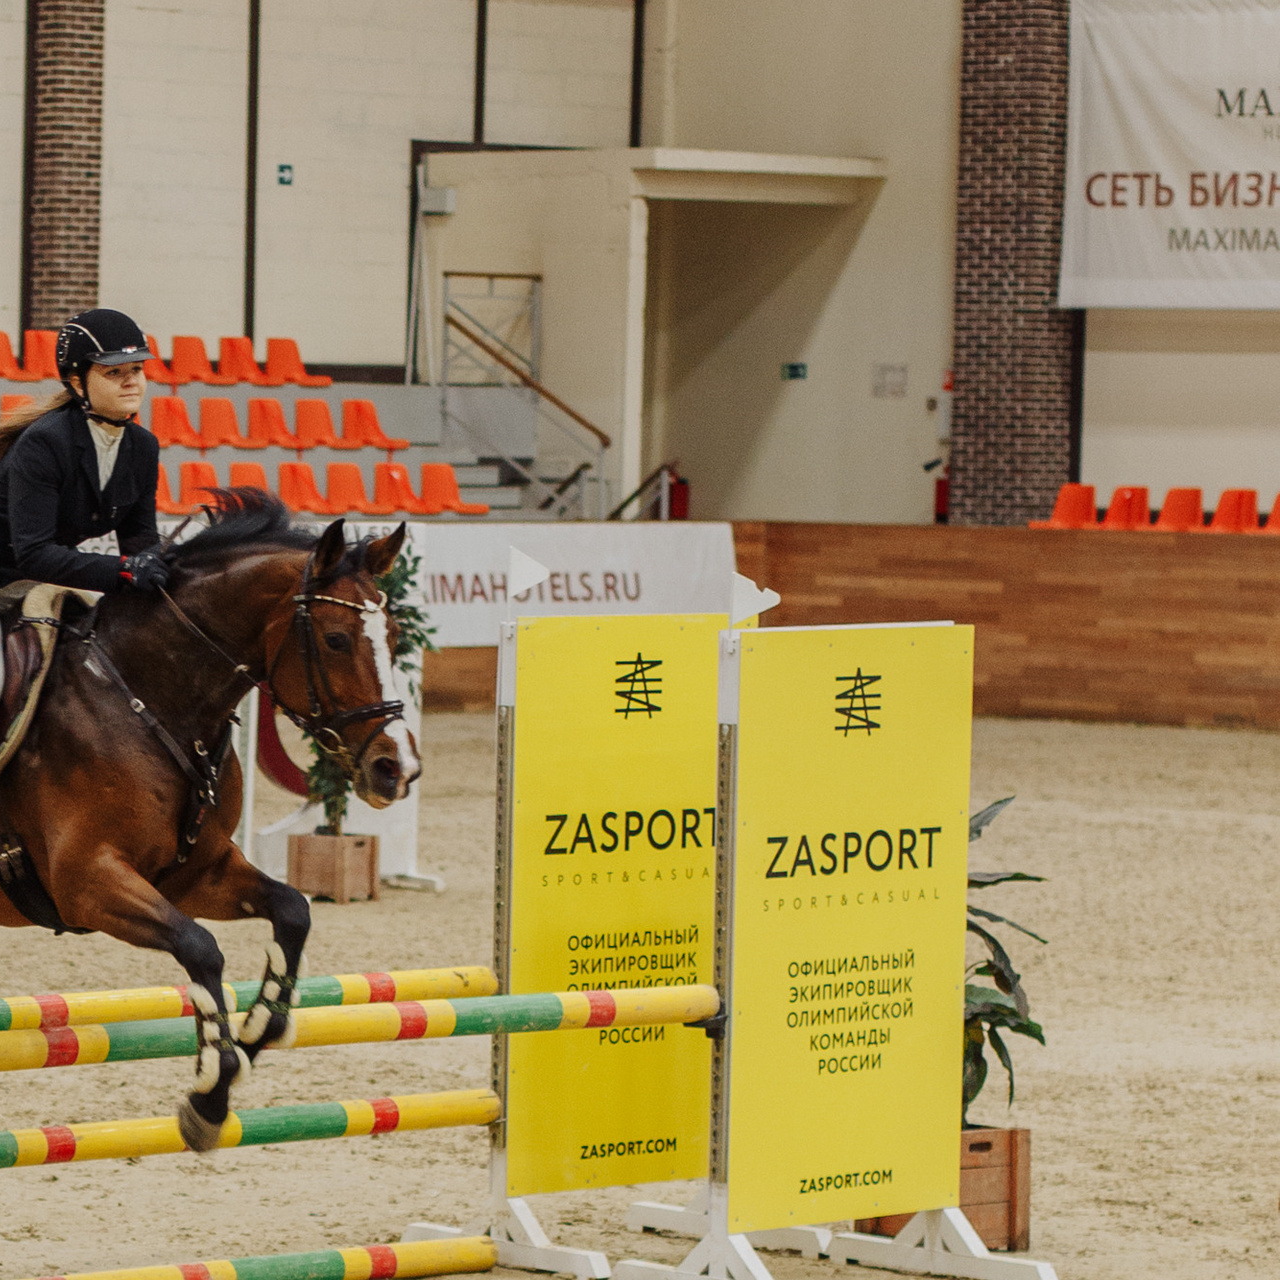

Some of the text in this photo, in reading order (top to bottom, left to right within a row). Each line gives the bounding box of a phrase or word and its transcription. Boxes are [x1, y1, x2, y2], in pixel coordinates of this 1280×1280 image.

[1084, 171, 1175, 208] СЕТЬ
[543, 807, 716, 856] ZASPORT
[765, 826, 942, 879] ZASPORT
[567, 924, 699, 952] ОФИЦИАЛЬНЫЙ
[569, 951, 697, 976] ЭКИПИРОВЩИК
[787, 948, 915, 979] ОФИЦИАЛЬНЫЙ
[789, 977, 912, 1006] ЭКИПИРОВЩИК
[786, 1001, 914, 1029] ОЛИМПИЙСКОЙ
[599, 1025, 665, 1046] РОССИИ
[809, 1027, 891, 1051] КОМАНДЫ
[818, 1052, 882, 1075] РОССИИ
[580, 1137, 677, 1160] ZASPORT.COM
[799, 1169, 893, 1194] ZASPORT.COM
